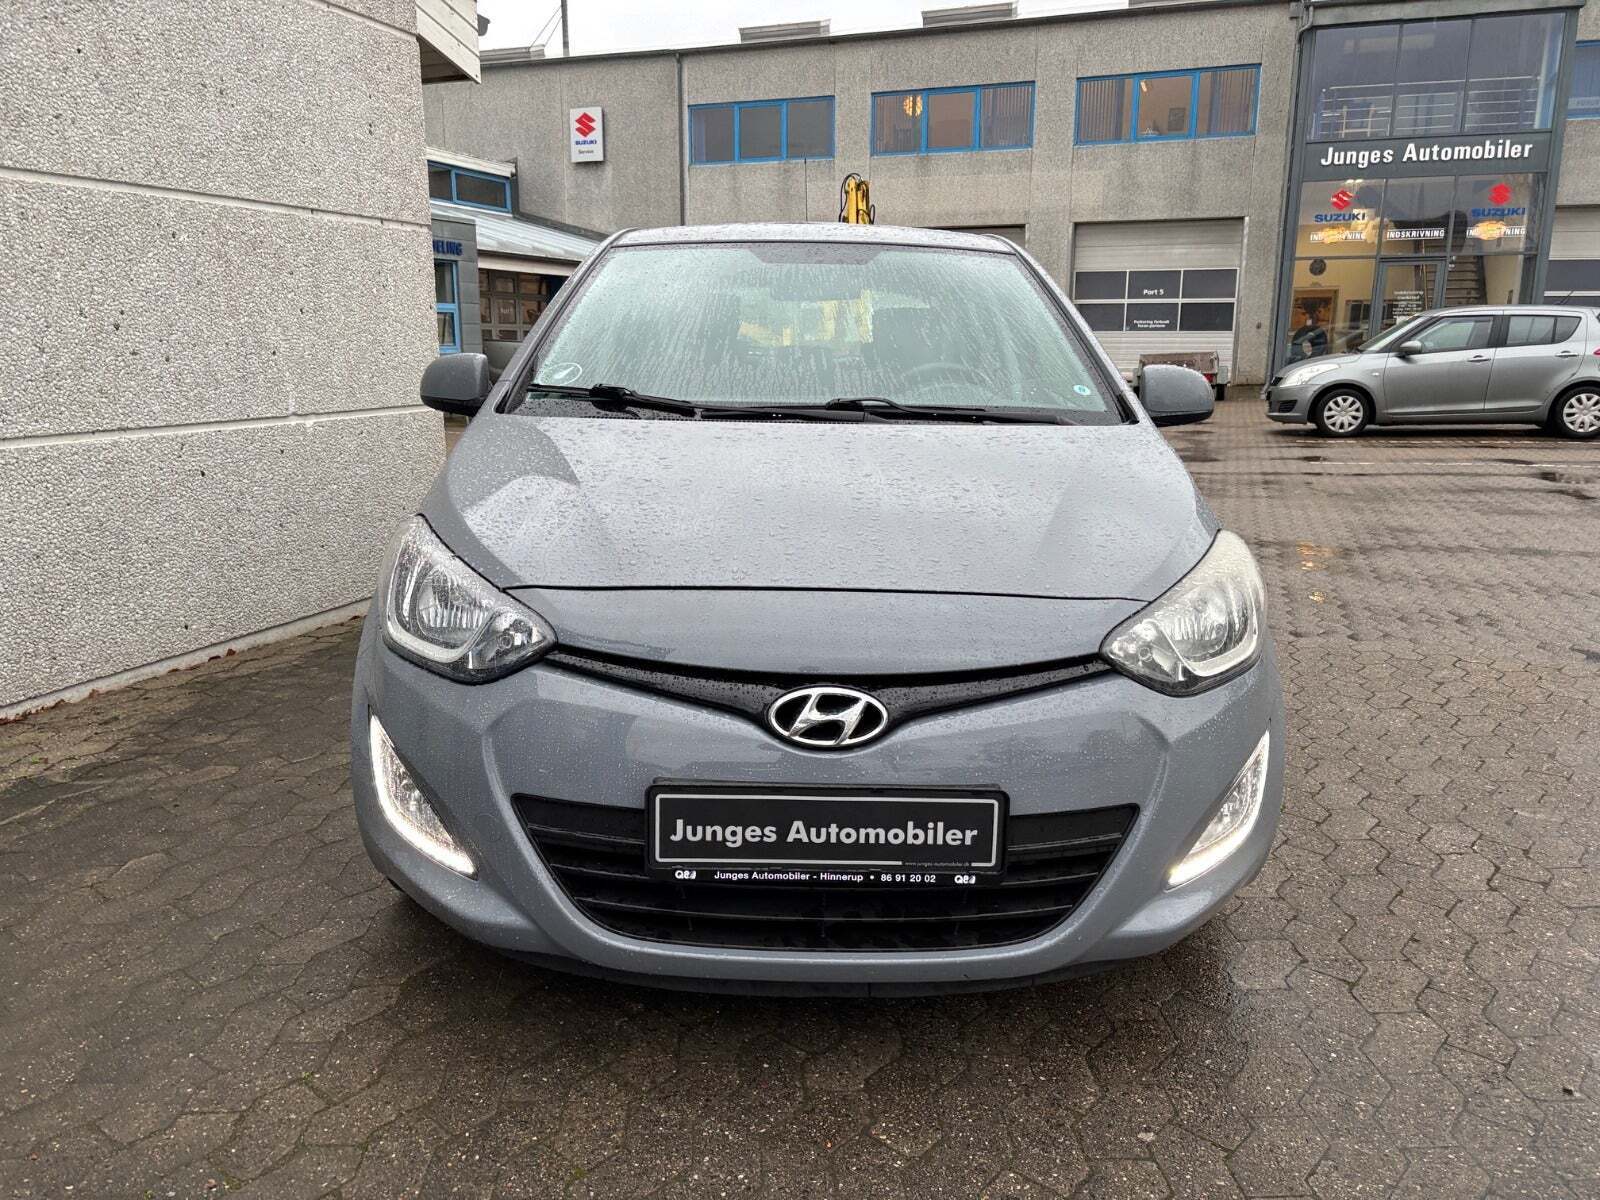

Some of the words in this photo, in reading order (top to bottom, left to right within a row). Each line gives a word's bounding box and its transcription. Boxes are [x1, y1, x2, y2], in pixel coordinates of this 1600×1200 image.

[1320, 147, 1394, 168] Junges
[1402, 139, 1533, 162] Automobiler
[1314, 212, 1366, 223] SUZUKI
[1471, 207, 1526, 218] SUZUKI
[1386, 229, 1445, 239] INDSKRIVNING
[1466, 227, 1526, 237] INNING
[670, 818, 777, 848] Junges
[786, 820, 978, 846] Automobiler
[714, 871, 749, 881] Junges
[751, 871, 810, 880] Automobiler
[819, 872, 864, 883] Hinnerup
[880, 874, 893, 882] 86
[895, 874, 906, 882] 91
[924, 875, 936, 883] 02
